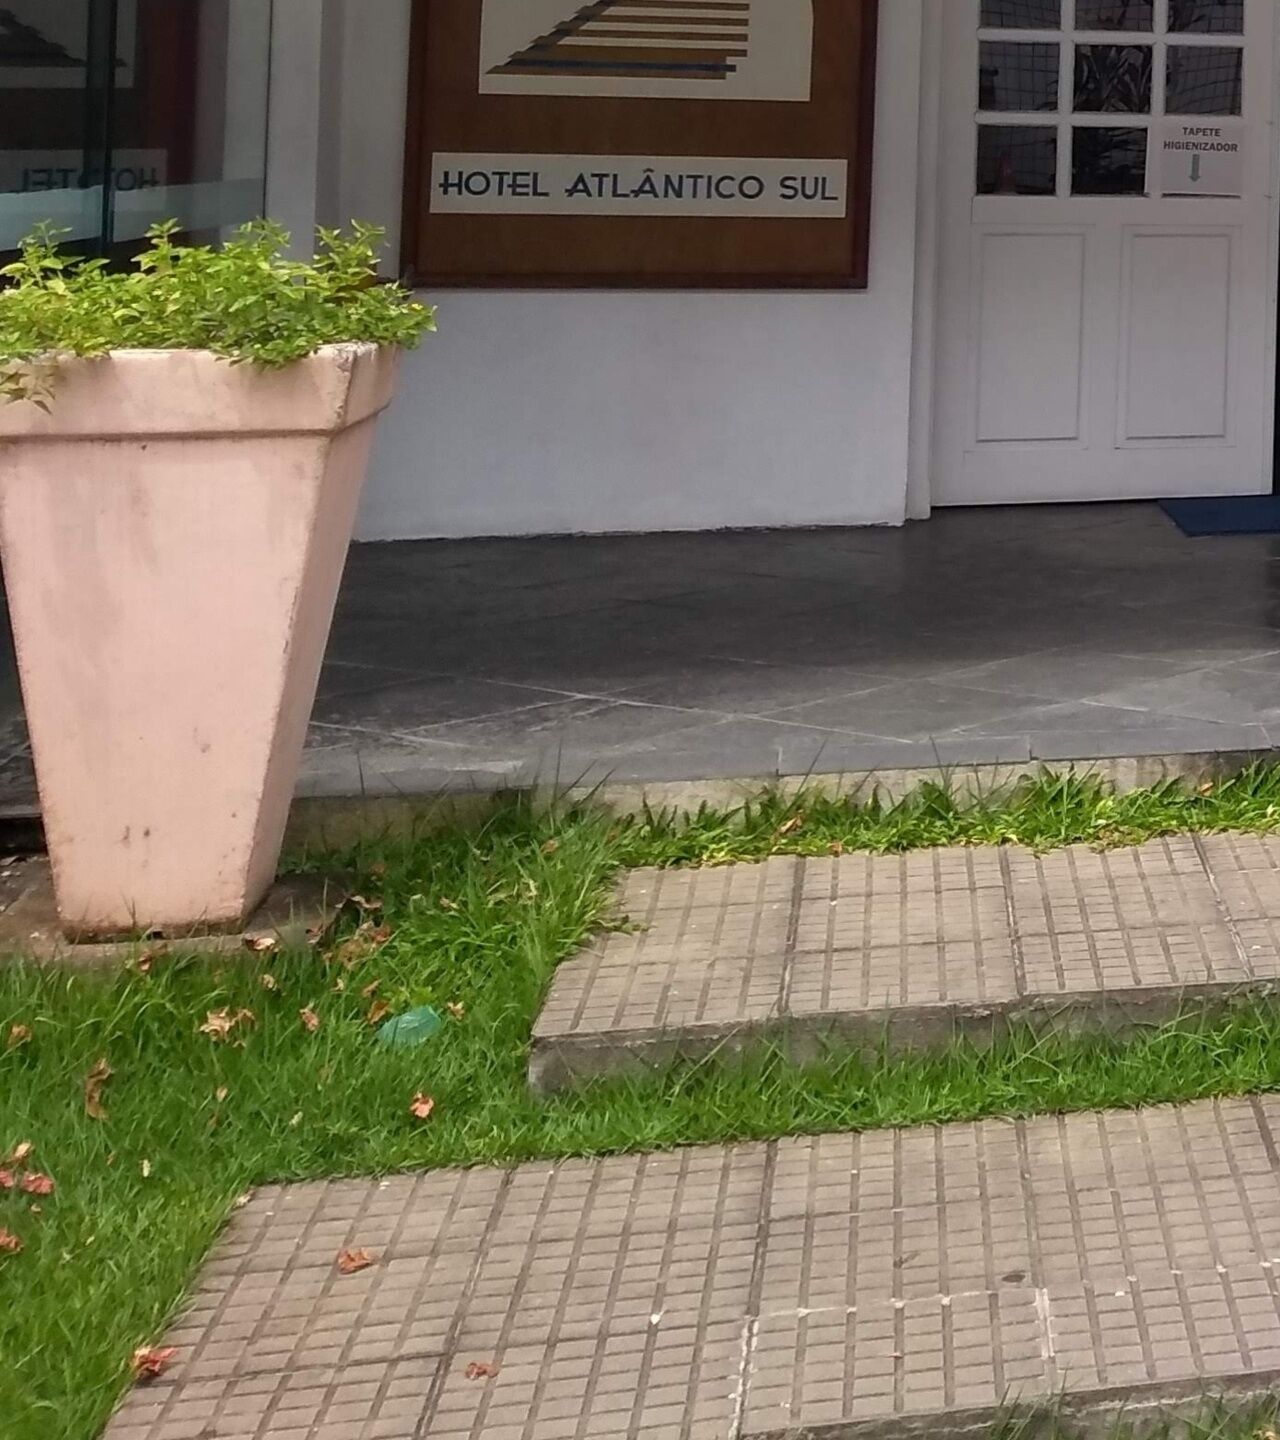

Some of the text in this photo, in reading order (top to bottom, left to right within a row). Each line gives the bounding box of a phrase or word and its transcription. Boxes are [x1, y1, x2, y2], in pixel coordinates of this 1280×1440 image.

[1182, 127, 1222, 137] TAPETE
[1163, 141, 1239, 152] HIGIENIZADOR
[438, 168, 839, 201] HOTEL ATLÂNTICO SUL
